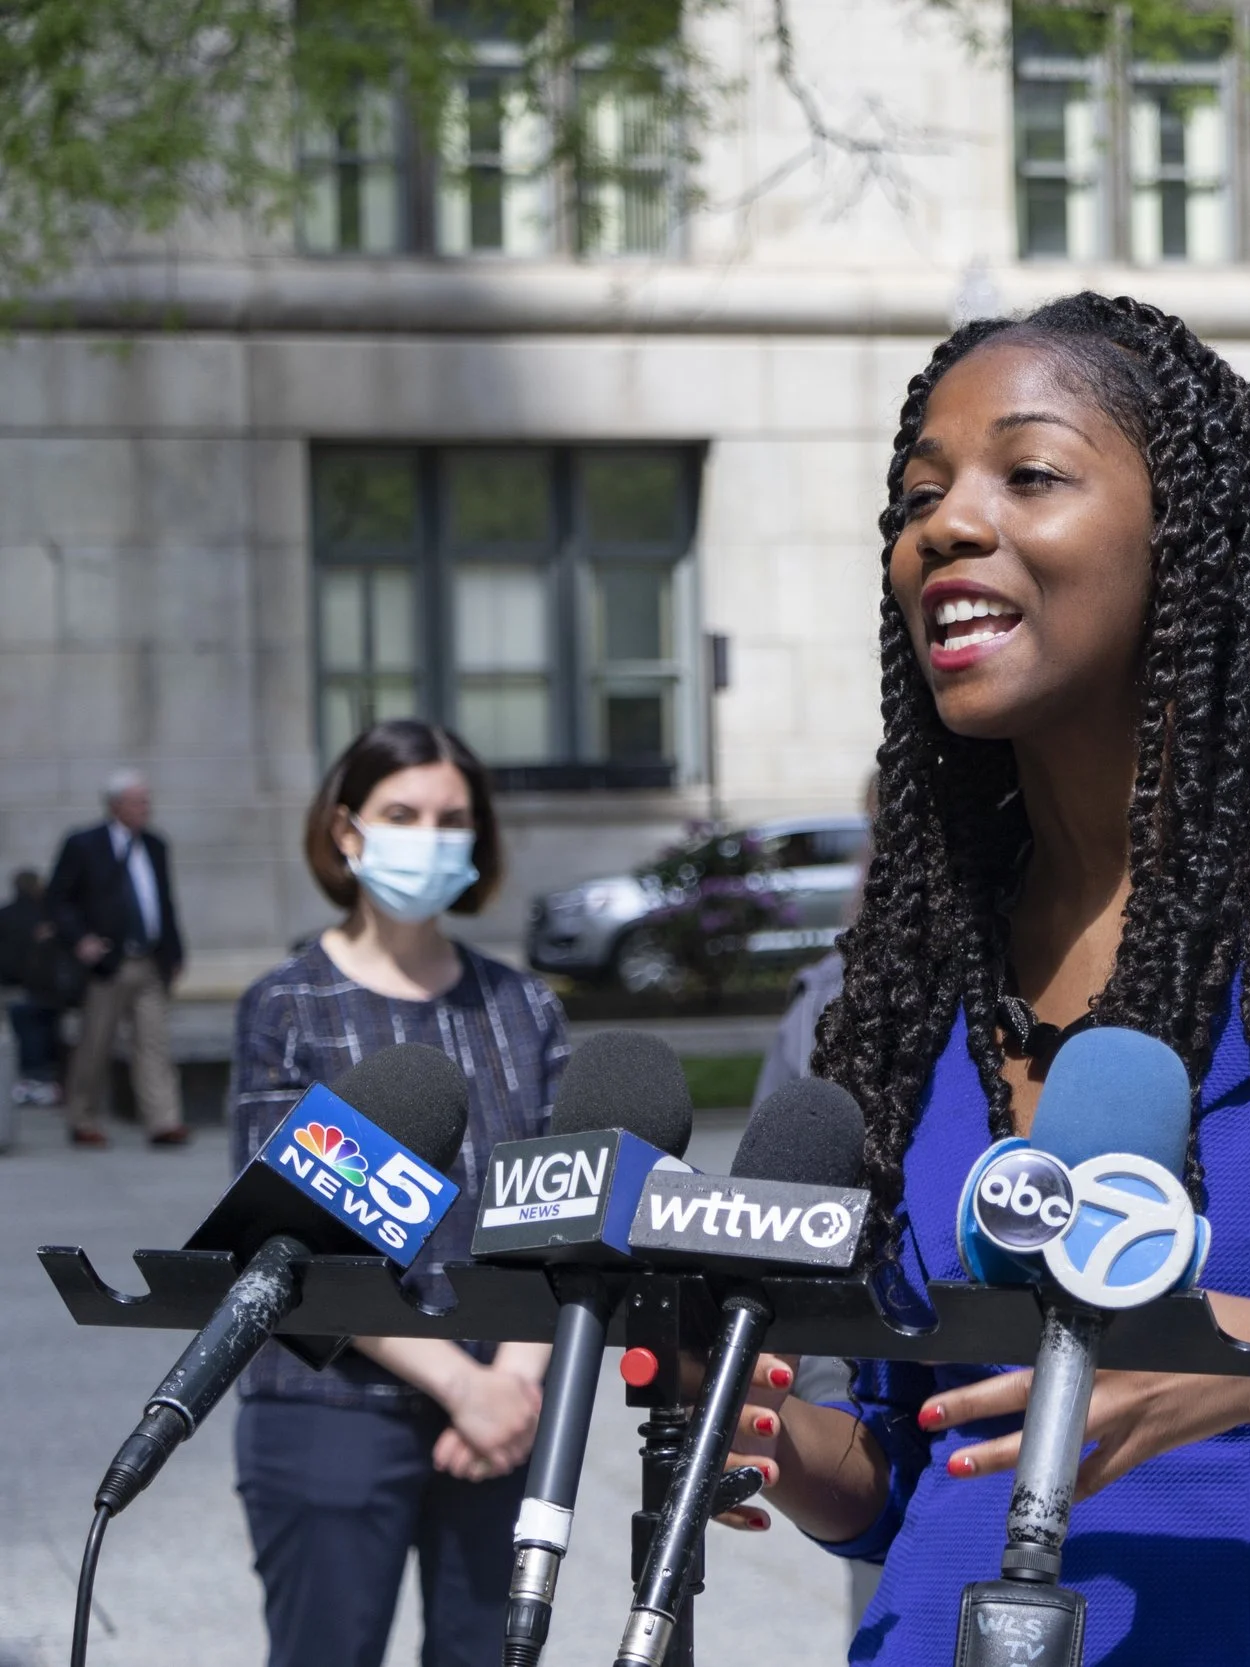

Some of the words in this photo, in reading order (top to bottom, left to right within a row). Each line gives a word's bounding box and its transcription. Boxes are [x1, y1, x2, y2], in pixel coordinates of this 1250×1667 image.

[279, 1145, 407, 1249] NEWS
[368, 1152, 443, 1224] 5
[495, 1147, 609, 1207] WGN
[980, 1171, 1071, 1227] abc
[518, 1203, 561, 1221] NEWS
[651, 1192, 803, 1242] wttw
[1064, 1168, 1190, 1295] 7
[977, 1611, 1042, 1641] WLS
[1003, 1640, 1045, 1660] TV
